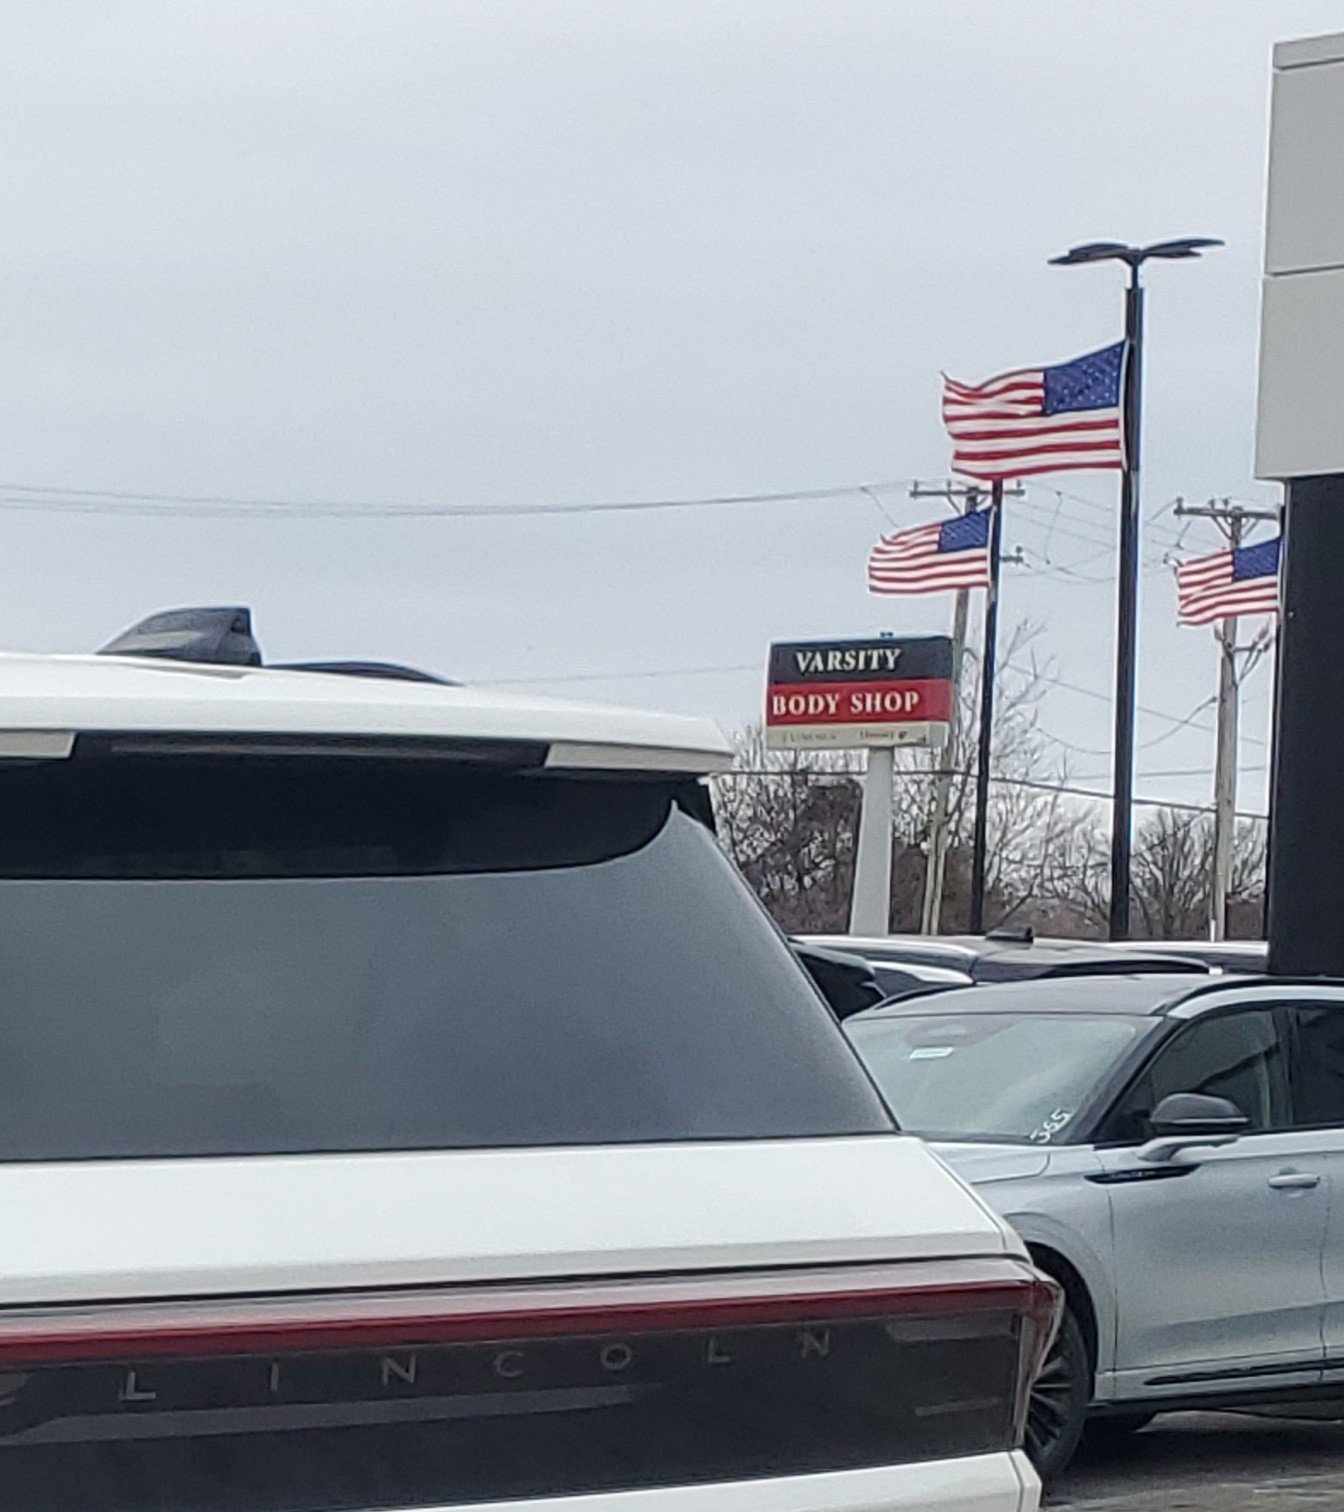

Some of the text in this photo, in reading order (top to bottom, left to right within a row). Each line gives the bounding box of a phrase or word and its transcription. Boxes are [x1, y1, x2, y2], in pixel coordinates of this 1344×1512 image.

[795, 649, 901, 672] VARSITY
[772, 691, 919, 716] BODY SHOP
[121, 1328, 831, 1402] LINCOLN
